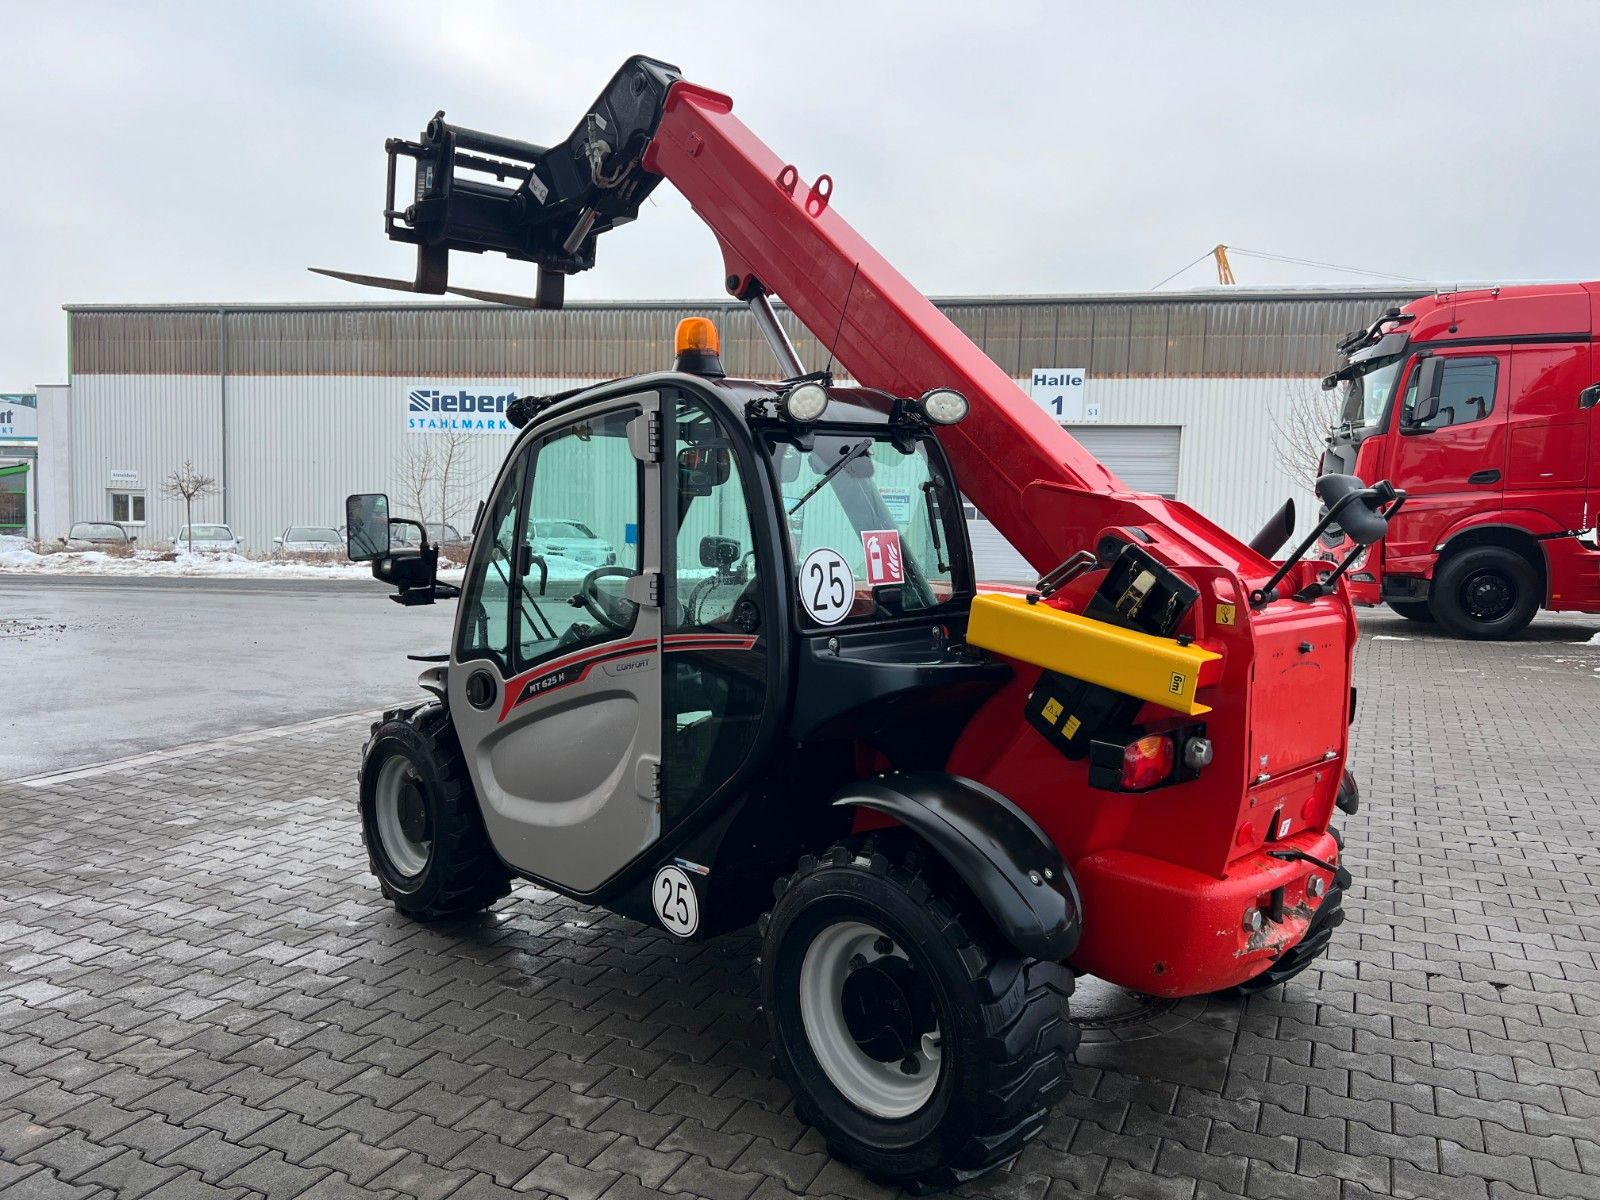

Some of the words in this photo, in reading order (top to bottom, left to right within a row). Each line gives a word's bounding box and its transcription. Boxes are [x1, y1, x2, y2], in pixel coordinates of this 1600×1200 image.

[1033, 374, 1083, 386] Halle
[1051, 395, 1063, 415] 1
[409, 418, 515, 430] STAHLMARK
[810, 560, 845, 611] 25
[616, 658, 650, 672] COMFORT
[529, 682, 541, 694] MT
[541, 676, 558, 689] 625
[558, 672, 565, 683] H
[662, 877, 689, 926] 25
